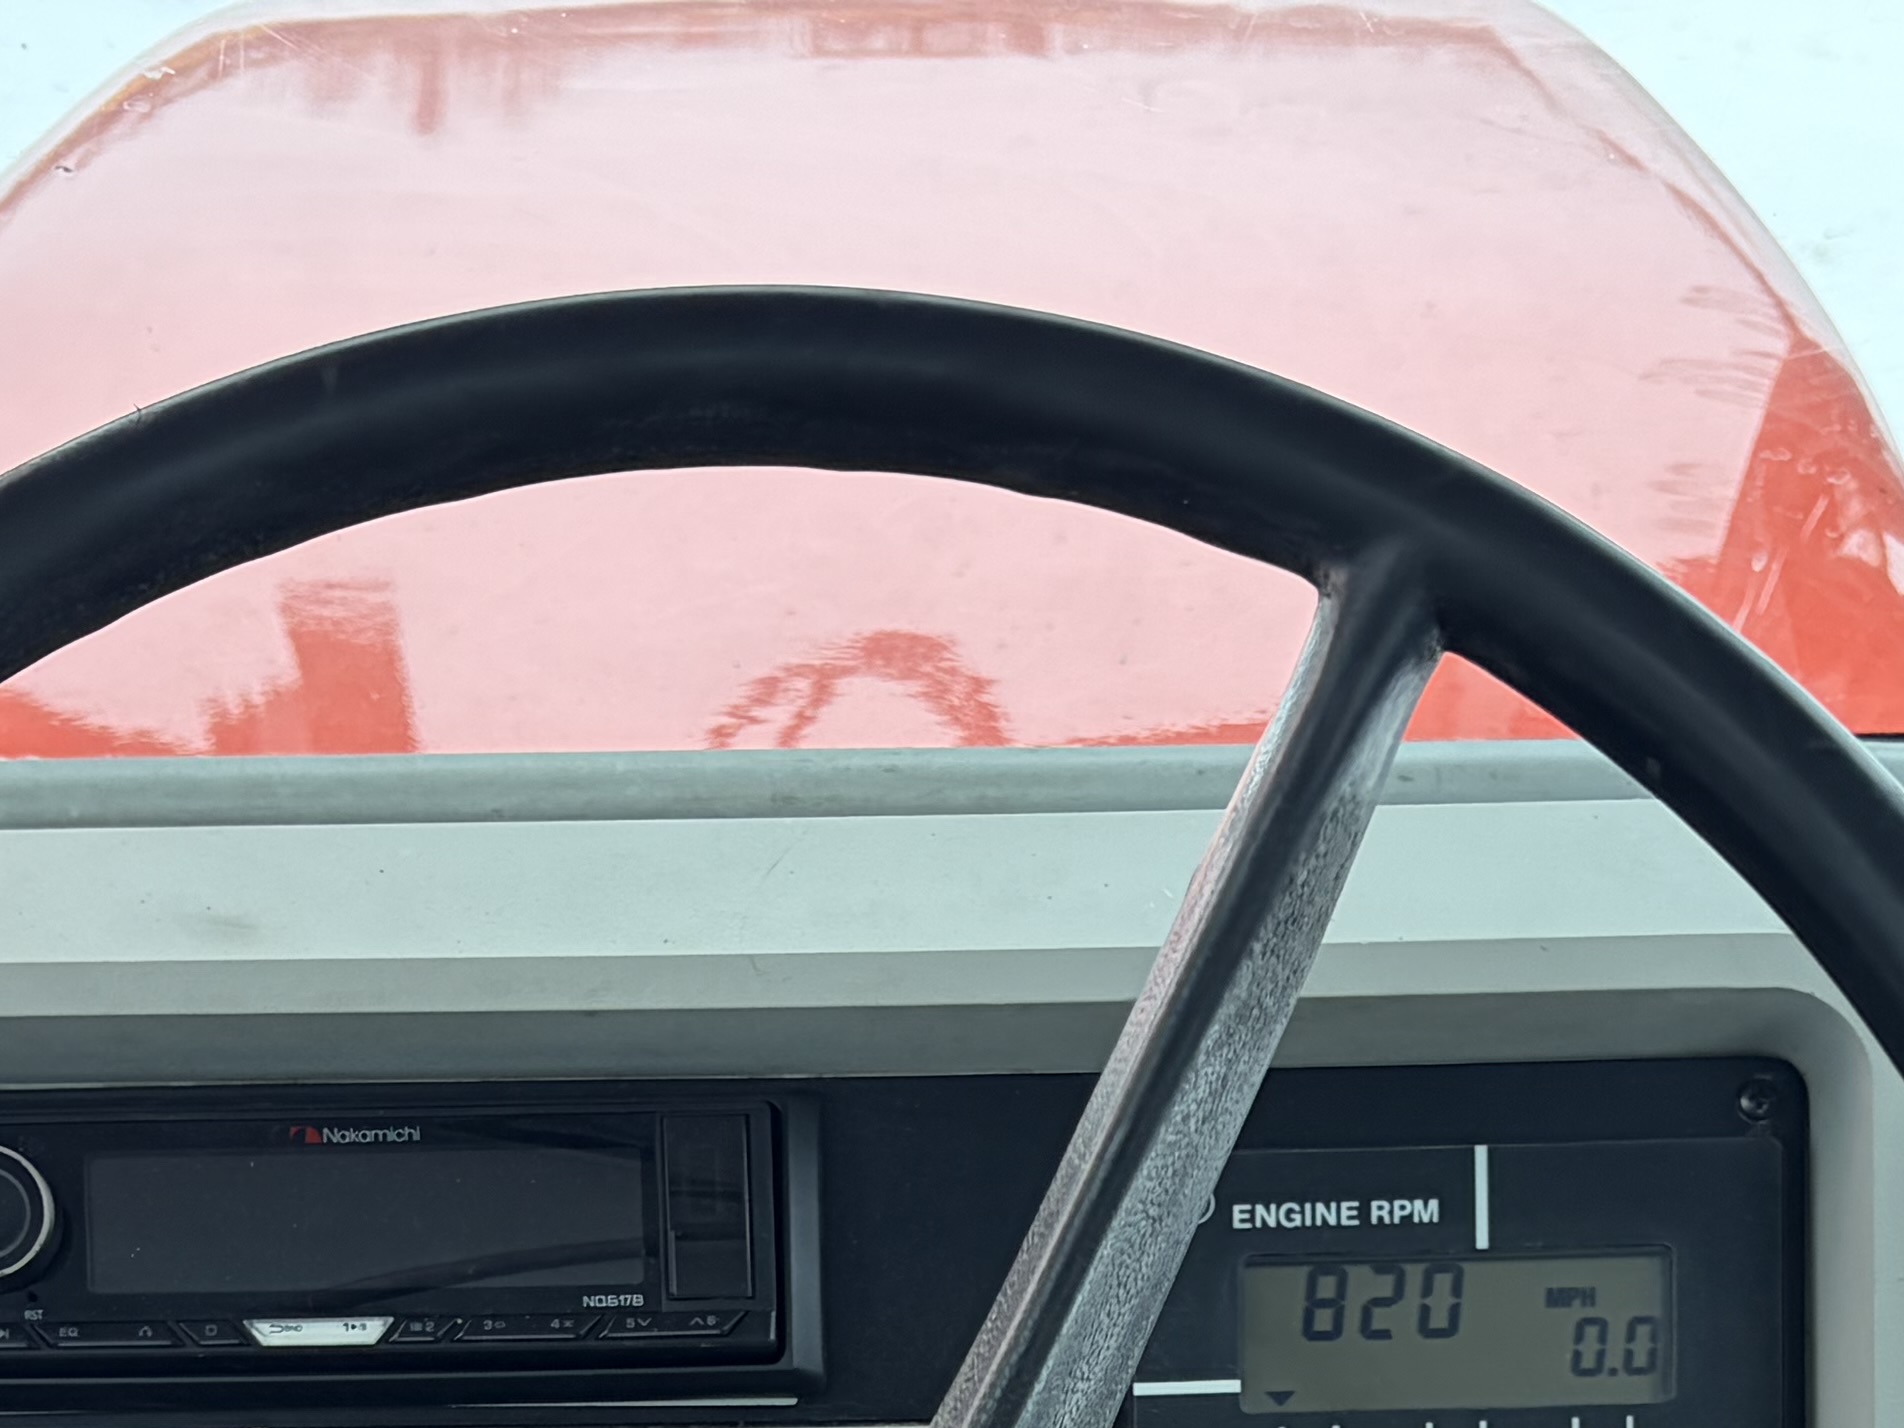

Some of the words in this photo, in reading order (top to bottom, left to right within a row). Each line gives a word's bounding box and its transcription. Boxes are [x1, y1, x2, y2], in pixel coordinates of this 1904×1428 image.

[323, 1127, 420, 1143] Nakamichi
[1233, 1201, 1359, 1228] ENGINE
[1370, 1198, 1440, 1225] RPM
[1301, 1262, 1465, 1342] 820
[1547, 1288, 1595, 1307] MPH
[59, 1328, 78, 1336] EQ
[1570, 1315, 1660, 1378] 0.0
